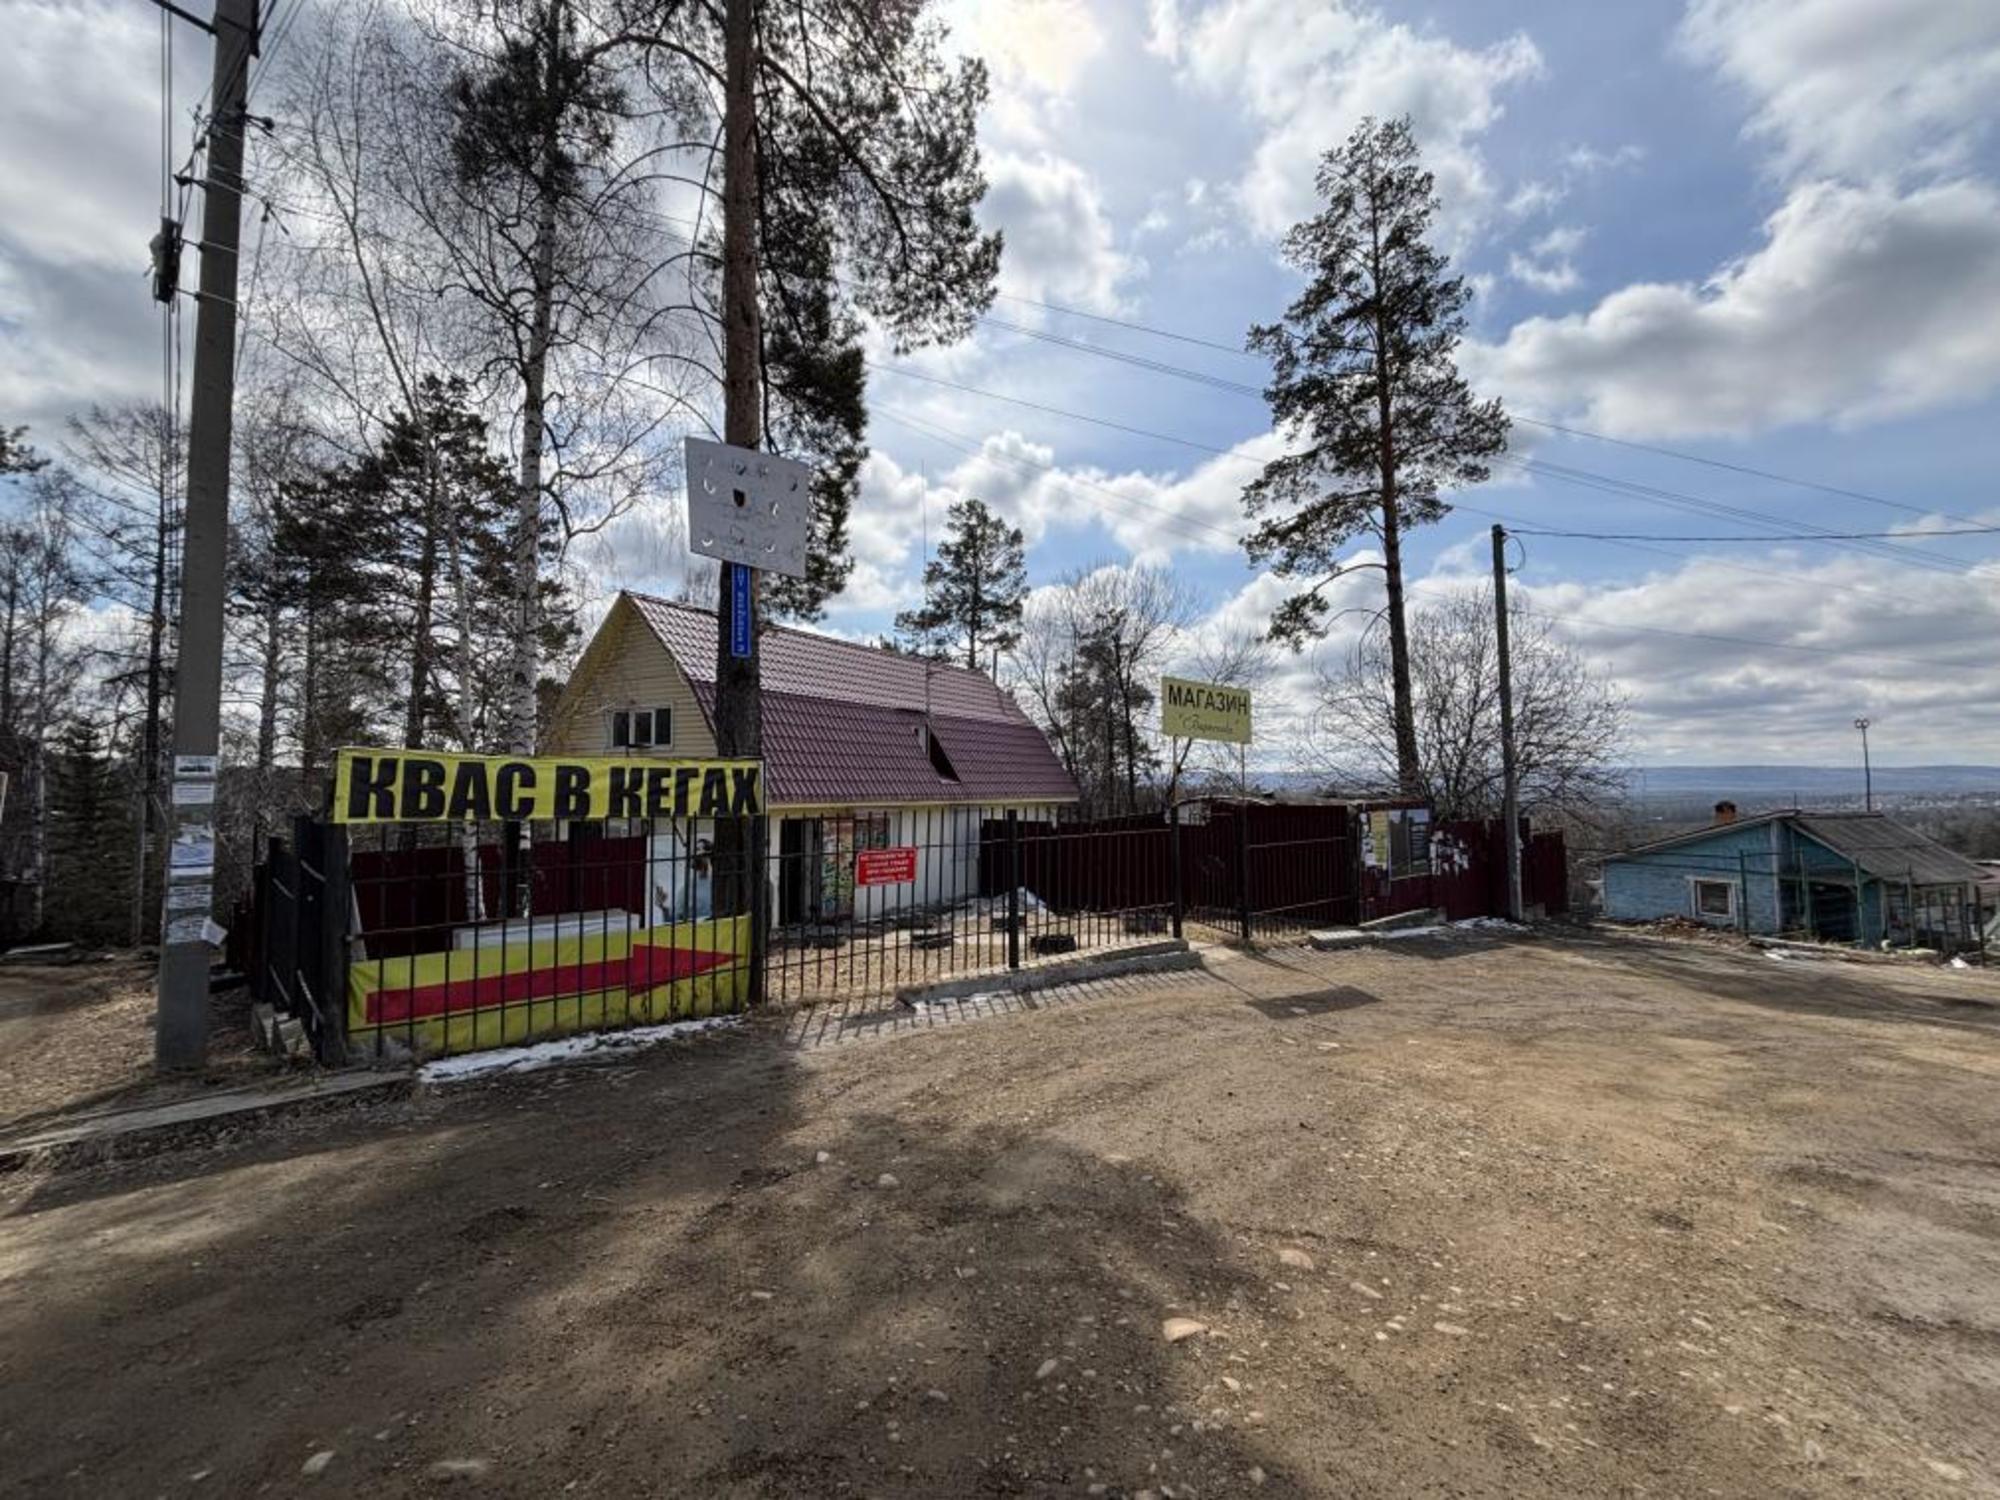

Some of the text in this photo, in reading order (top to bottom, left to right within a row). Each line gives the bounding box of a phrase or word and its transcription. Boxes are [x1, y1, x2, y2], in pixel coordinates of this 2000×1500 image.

[1168, 684, 1247, 715] МАГАЗИН
[348, 756, 760, 820] КВАС В КЕГАХ
